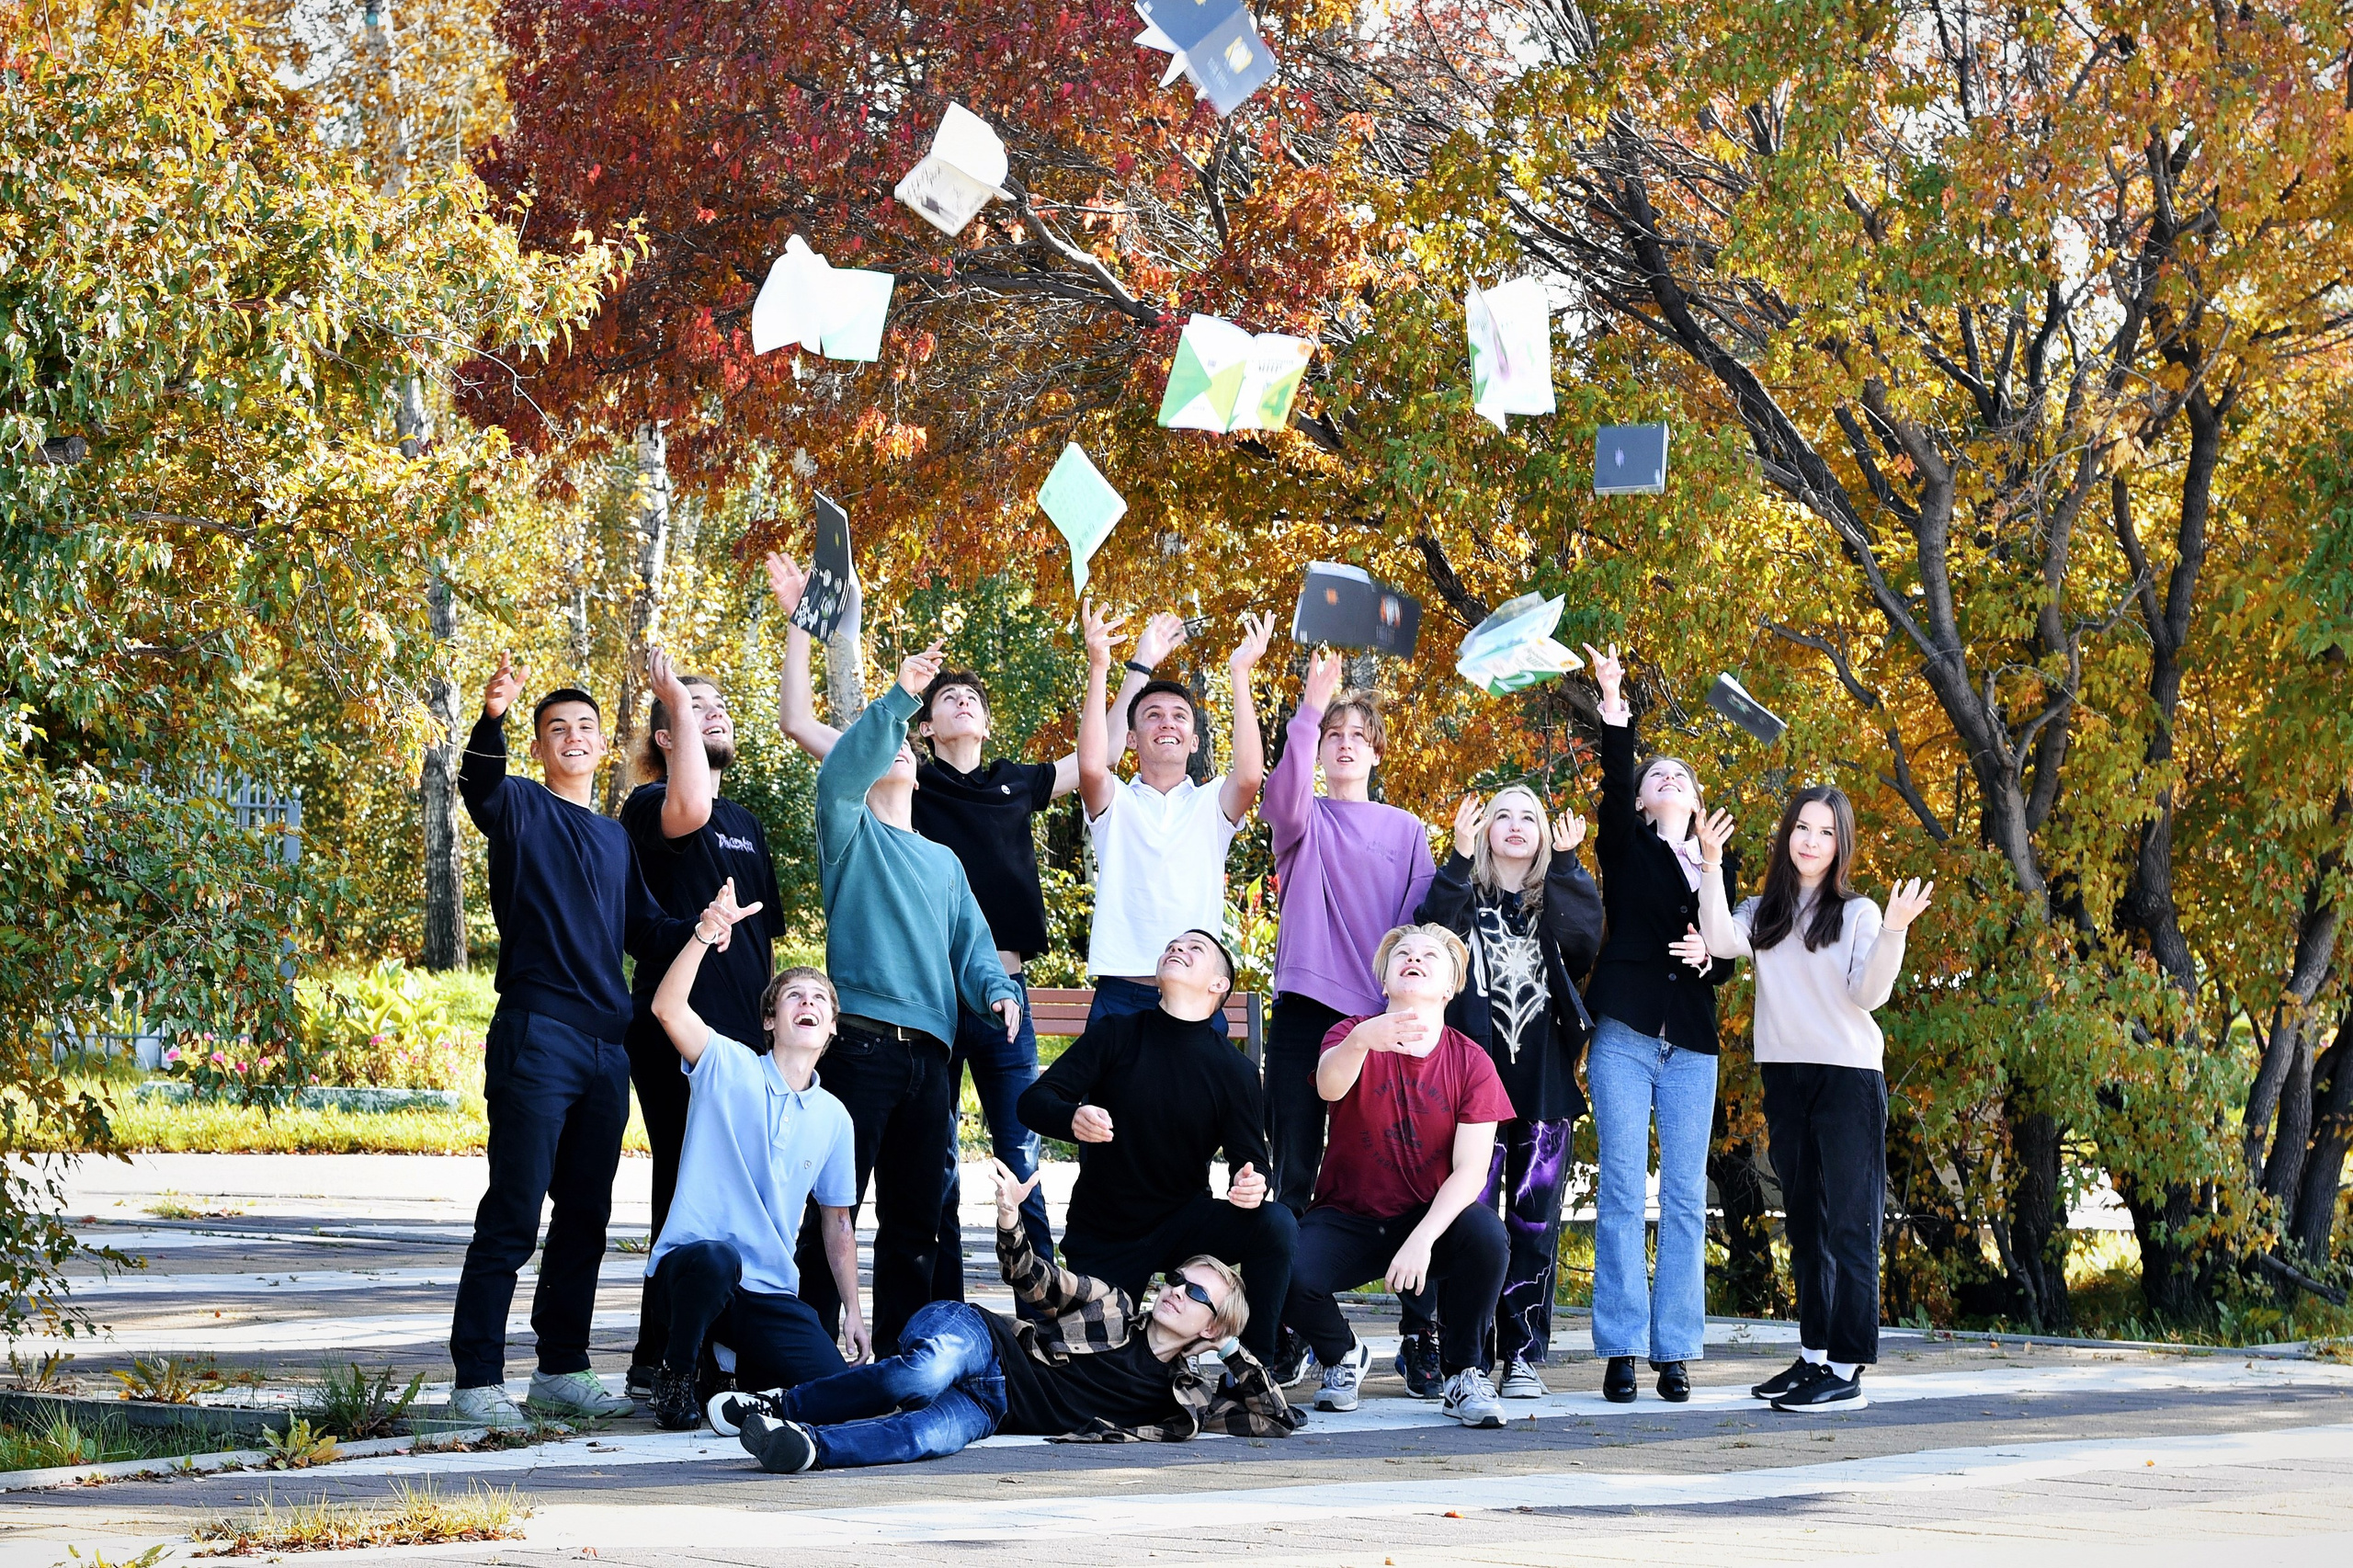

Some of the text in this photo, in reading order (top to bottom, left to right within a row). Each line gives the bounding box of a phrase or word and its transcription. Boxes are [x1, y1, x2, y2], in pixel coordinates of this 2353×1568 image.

[1261, 382, 1292, 417] 4
[1374, 1079, 1393, 1096] THE
[1427, 1086, 1450, 1113] WITH
[1384, 1129, 1423, 1149] adas
